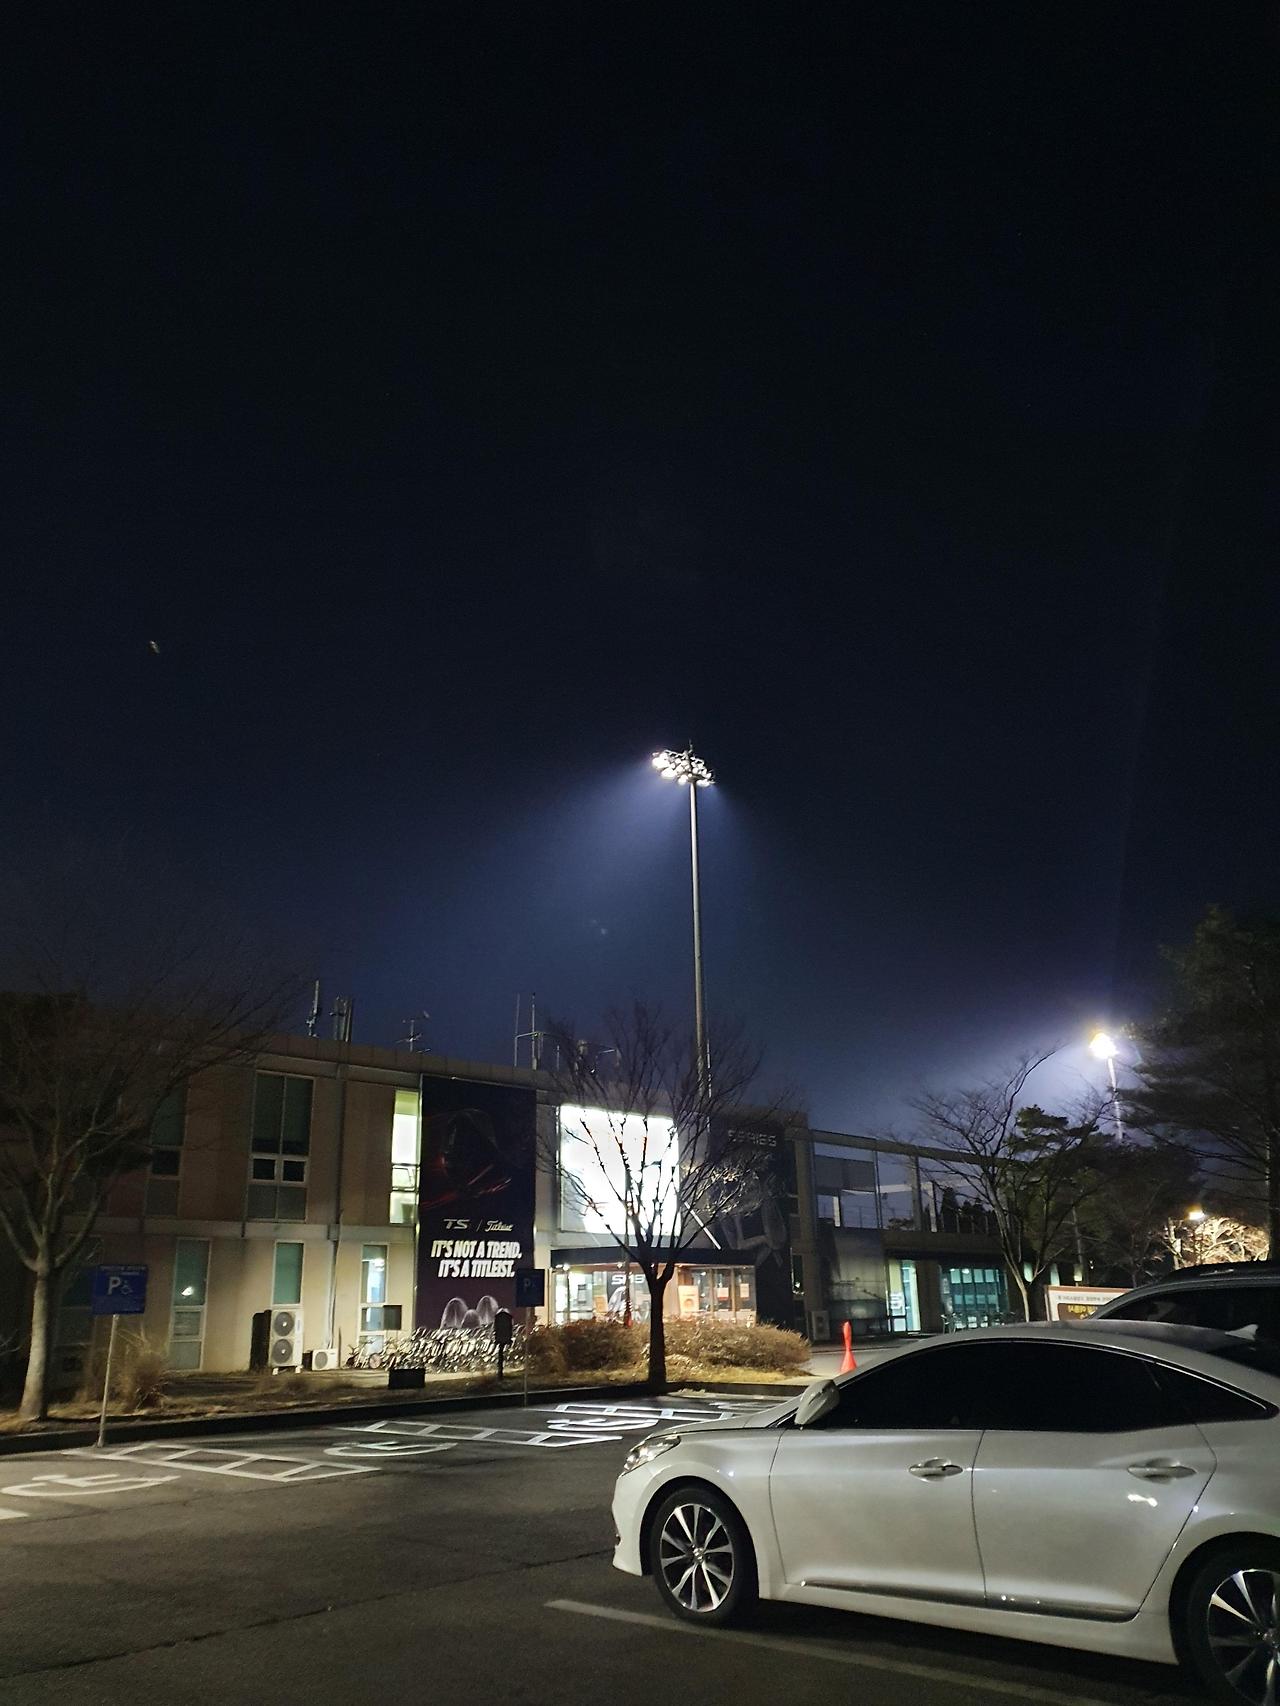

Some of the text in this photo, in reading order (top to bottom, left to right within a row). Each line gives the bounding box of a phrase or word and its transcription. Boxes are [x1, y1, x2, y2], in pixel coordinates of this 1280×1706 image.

[431, 1240, 454, 1258] IT'S
[453, 1240, 477, 1258] NOT
[475, 1241, 485, 1258] A
[438, 1259, 461, 1278] IT'S
[459, 1260, 470, 1277] A
[107, 1277, 120, 1295] P
